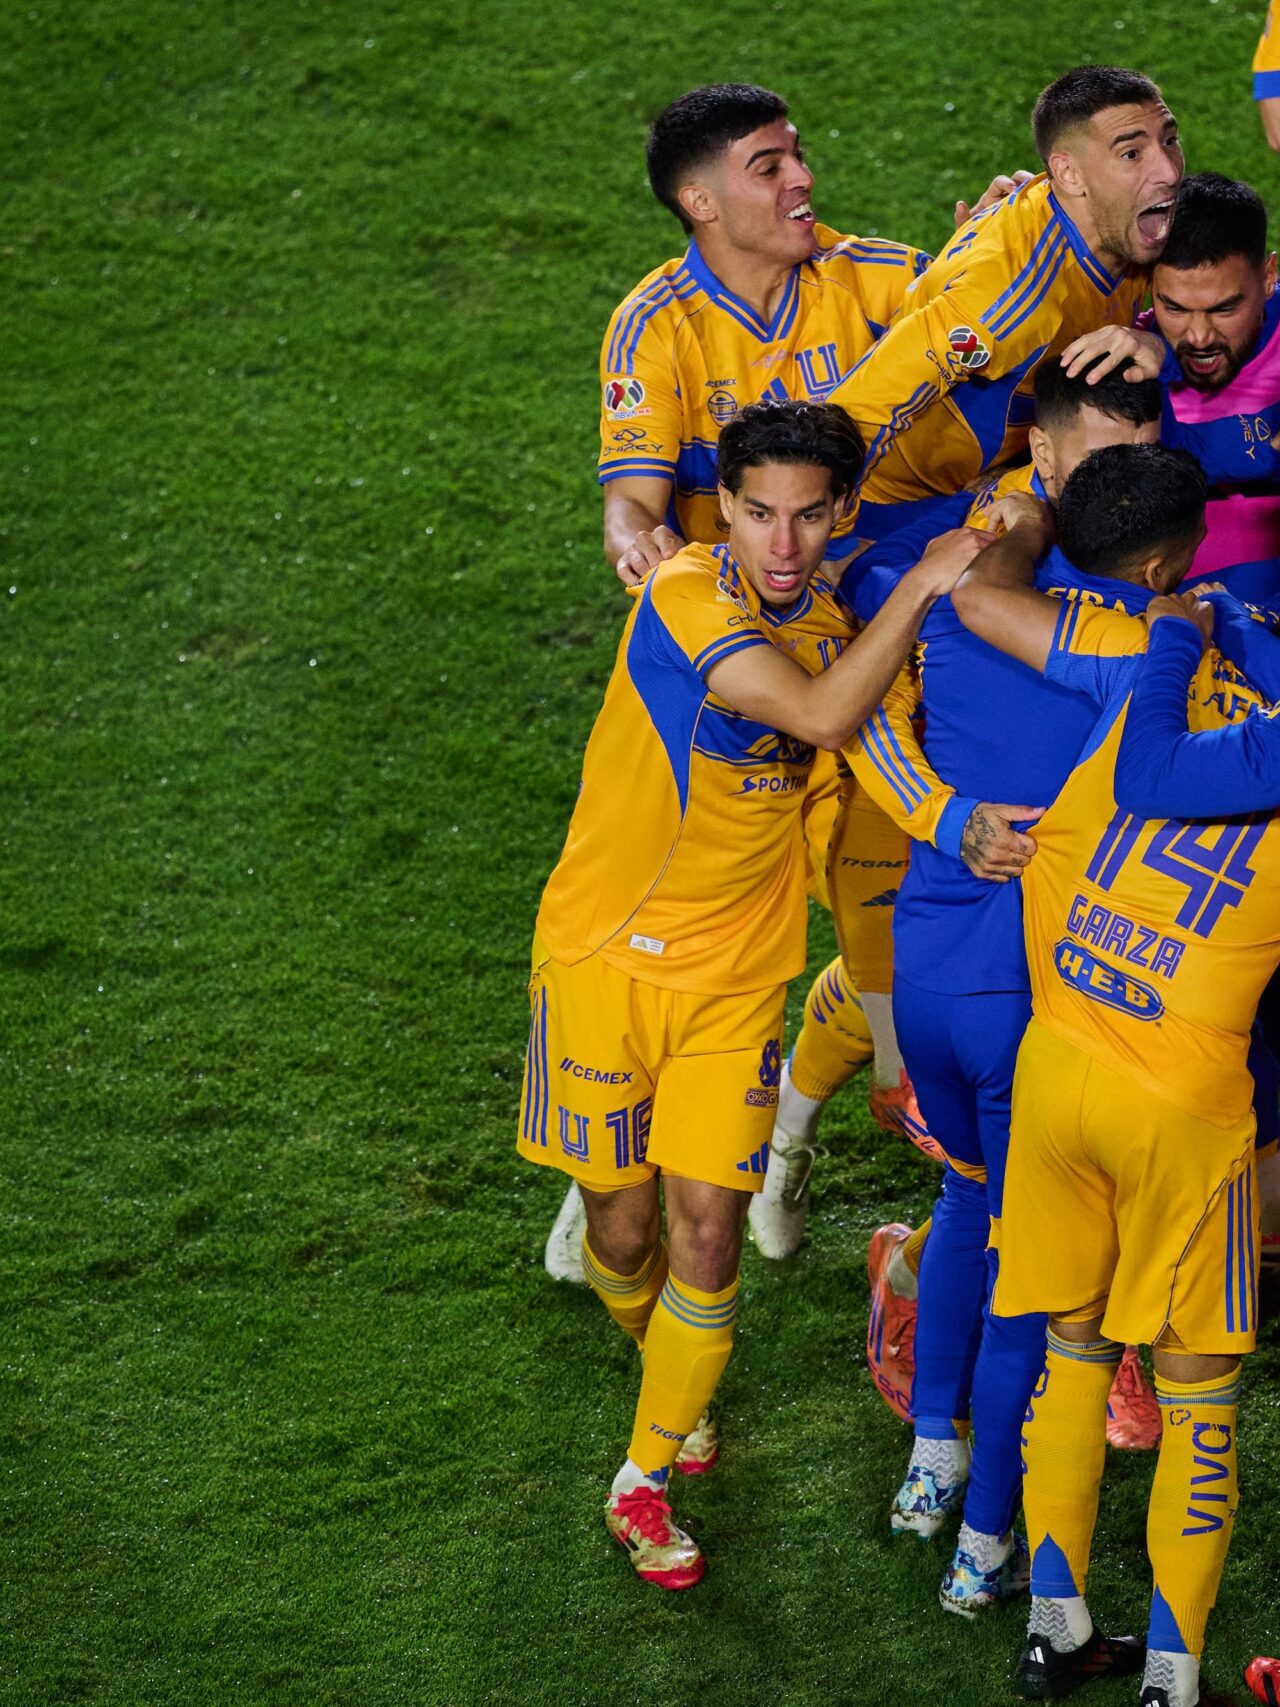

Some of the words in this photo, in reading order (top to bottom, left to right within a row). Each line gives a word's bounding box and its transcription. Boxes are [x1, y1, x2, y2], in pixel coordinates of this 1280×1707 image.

[615, 410, 638, 419] BBVA
[1085, 806, 1257, 939] 14
[1066, 894, 1187, 979] GARZA
[572, 1064, 634, 1085] CEMEX
[558, 1104, 590, 1157] U
